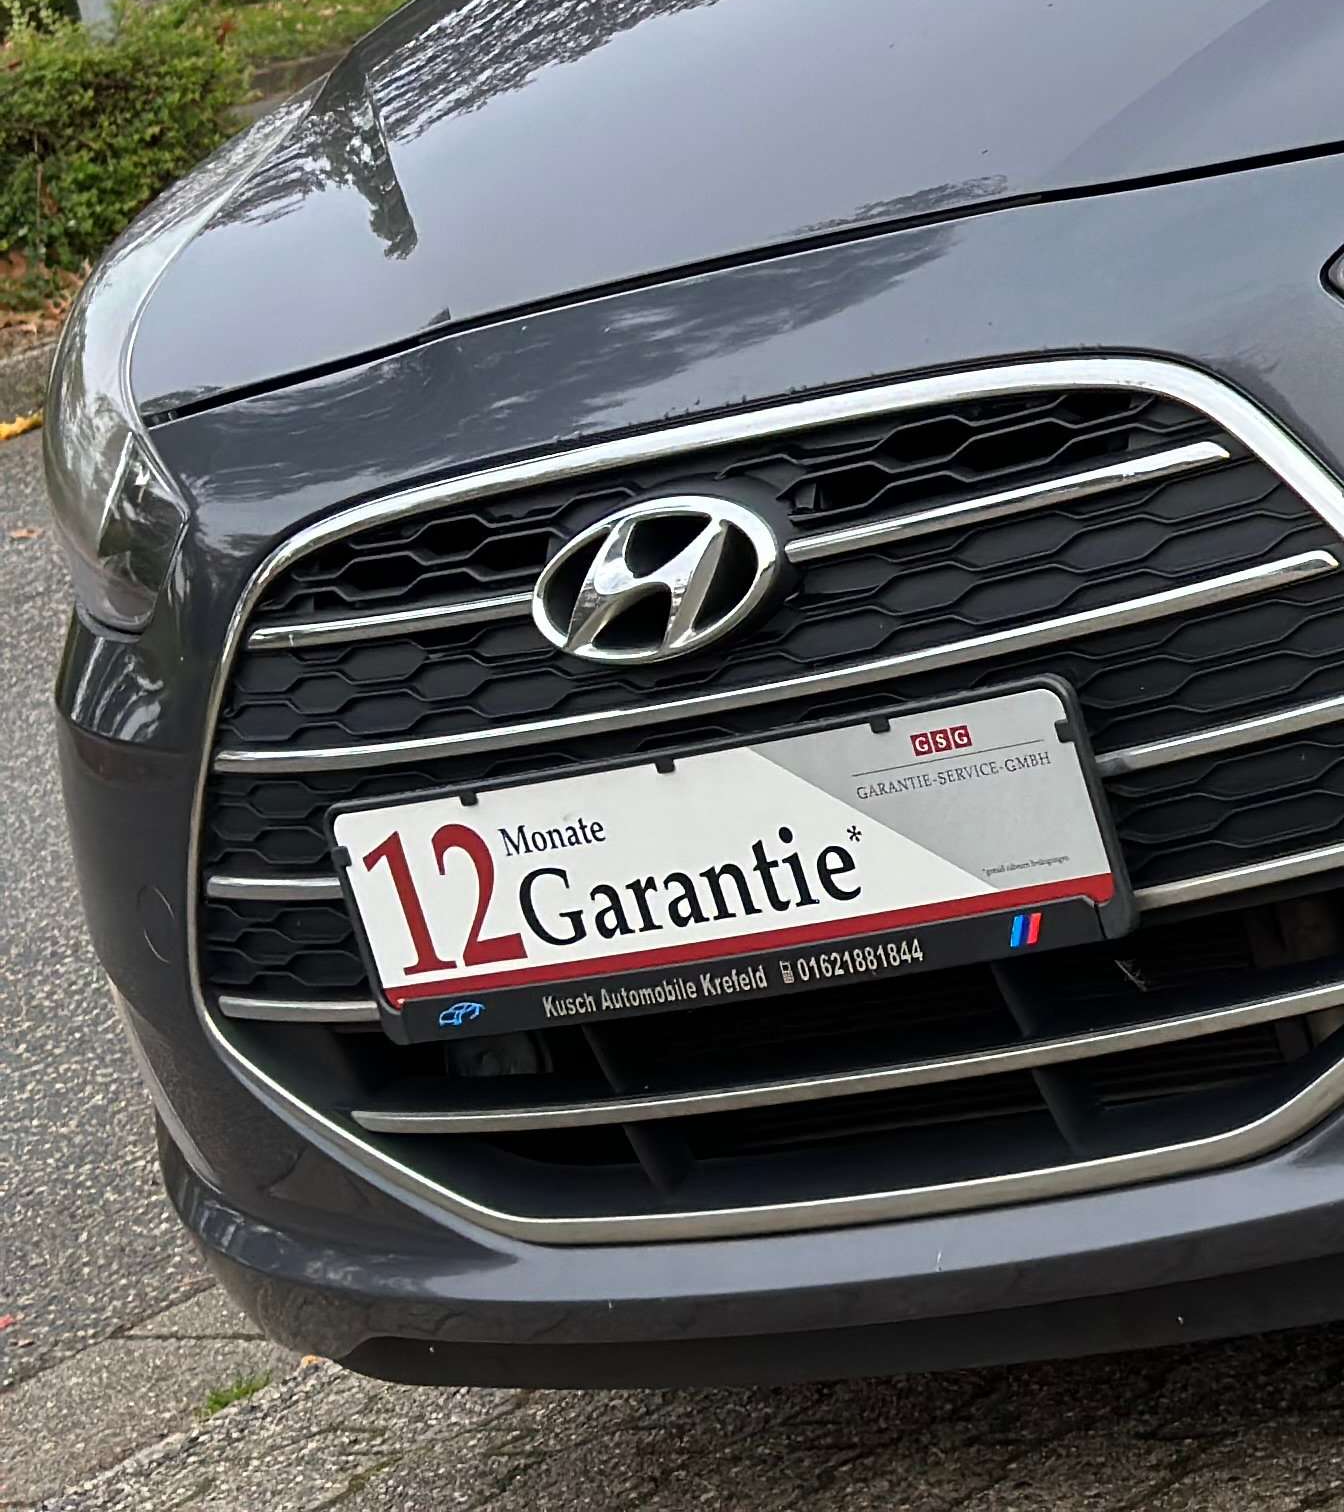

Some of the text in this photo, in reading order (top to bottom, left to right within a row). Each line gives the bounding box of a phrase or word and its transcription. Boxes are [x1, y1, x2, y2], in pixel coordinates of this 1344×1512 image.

[911, 725, 972, 755] GSG
[856, 751, 1052, 800] GARANTIE-SERVICE-GMBH
[499, 816, 606, 858] Monate
[362, 822, 529, 976] 12
[542, 939, 923, 1019] Kusch Automobile Krefeld 01621881844
